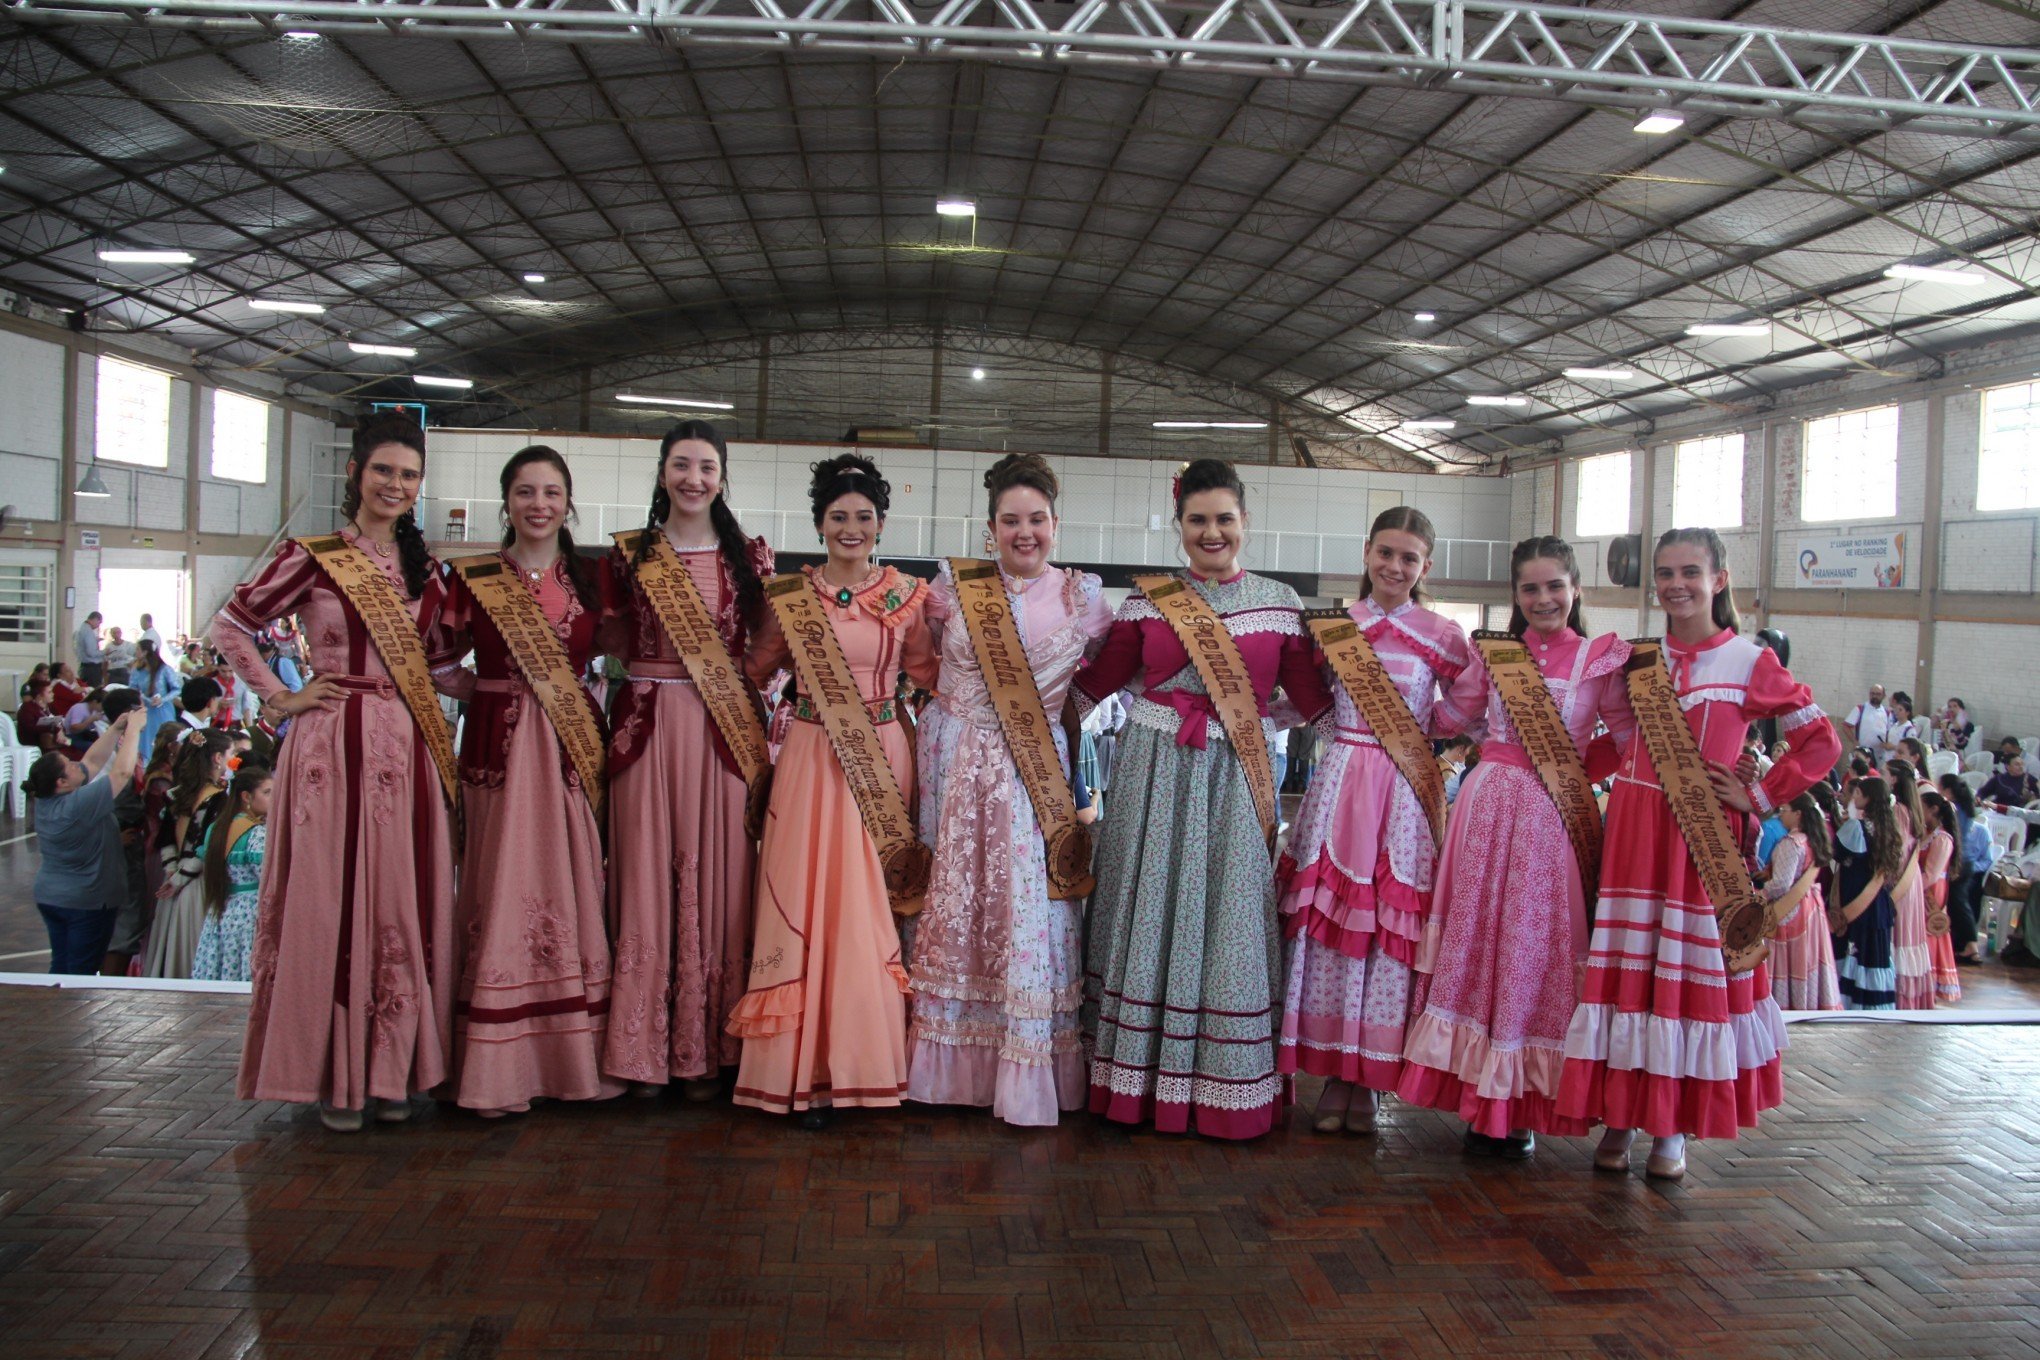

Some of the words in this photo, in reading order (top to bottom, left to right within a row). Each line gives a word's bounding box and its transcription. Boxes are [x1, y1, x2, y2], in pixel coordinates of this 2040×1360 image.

[1812, 568, 1858, 579] PARANHANANET
[1836, 540, 1852, 548] LUGAR
[1863, 538, 1887, 546] RANKING
[1854, 547, 1887, 556] VELOCIDADE
[347, 583, 407, 667] Juvenil
[361, 573, 416, 655] Prenda
[507, 592, 561, 672] Prenda
[645, 577, 701, 656] Juvenil
[662, 567, 712, 644] Prenda
[490, 605, 550, 683] Juvenil
[793, 619, 849, 707] Prenda
[973, 601, 1020, 688] Prenda
[1181, 614, 1242, 699] Prenda
[409, 676, 428, 704] Rio
[424, 700, 445, 745] Grande
[554, 692, 579, 717] Rio
[568, 715, 596, 758] Grande
[704, 666, 728, 691] Rio
[722, 690, 747, 730] Grande
[1236, 720, 1256, 747] Rio
[1344, 672, 1393, 738] Mirim
[1357, 661, 1412, 737] Prenda
[1508, 695, 1551, 765] Mirim
[1522, 686, 1571, 767] Prenda
[1635, 693, 1669, 763] Mirim
[1650, 685, 1693, 770] Prenda
[841, 728, 865, 756] Rio
[852, 753, 883, 801] Grande
[1010, 710, 1034, 739] Rio
[1022, 736, 1048, 783] Grande
[1243, 744, 1265, 789] Grande
[1562, 777, 1585, 806] Rio
[1680, 783, 1707, 819] Rio
[1695, 813, 1726, 859] Grande
